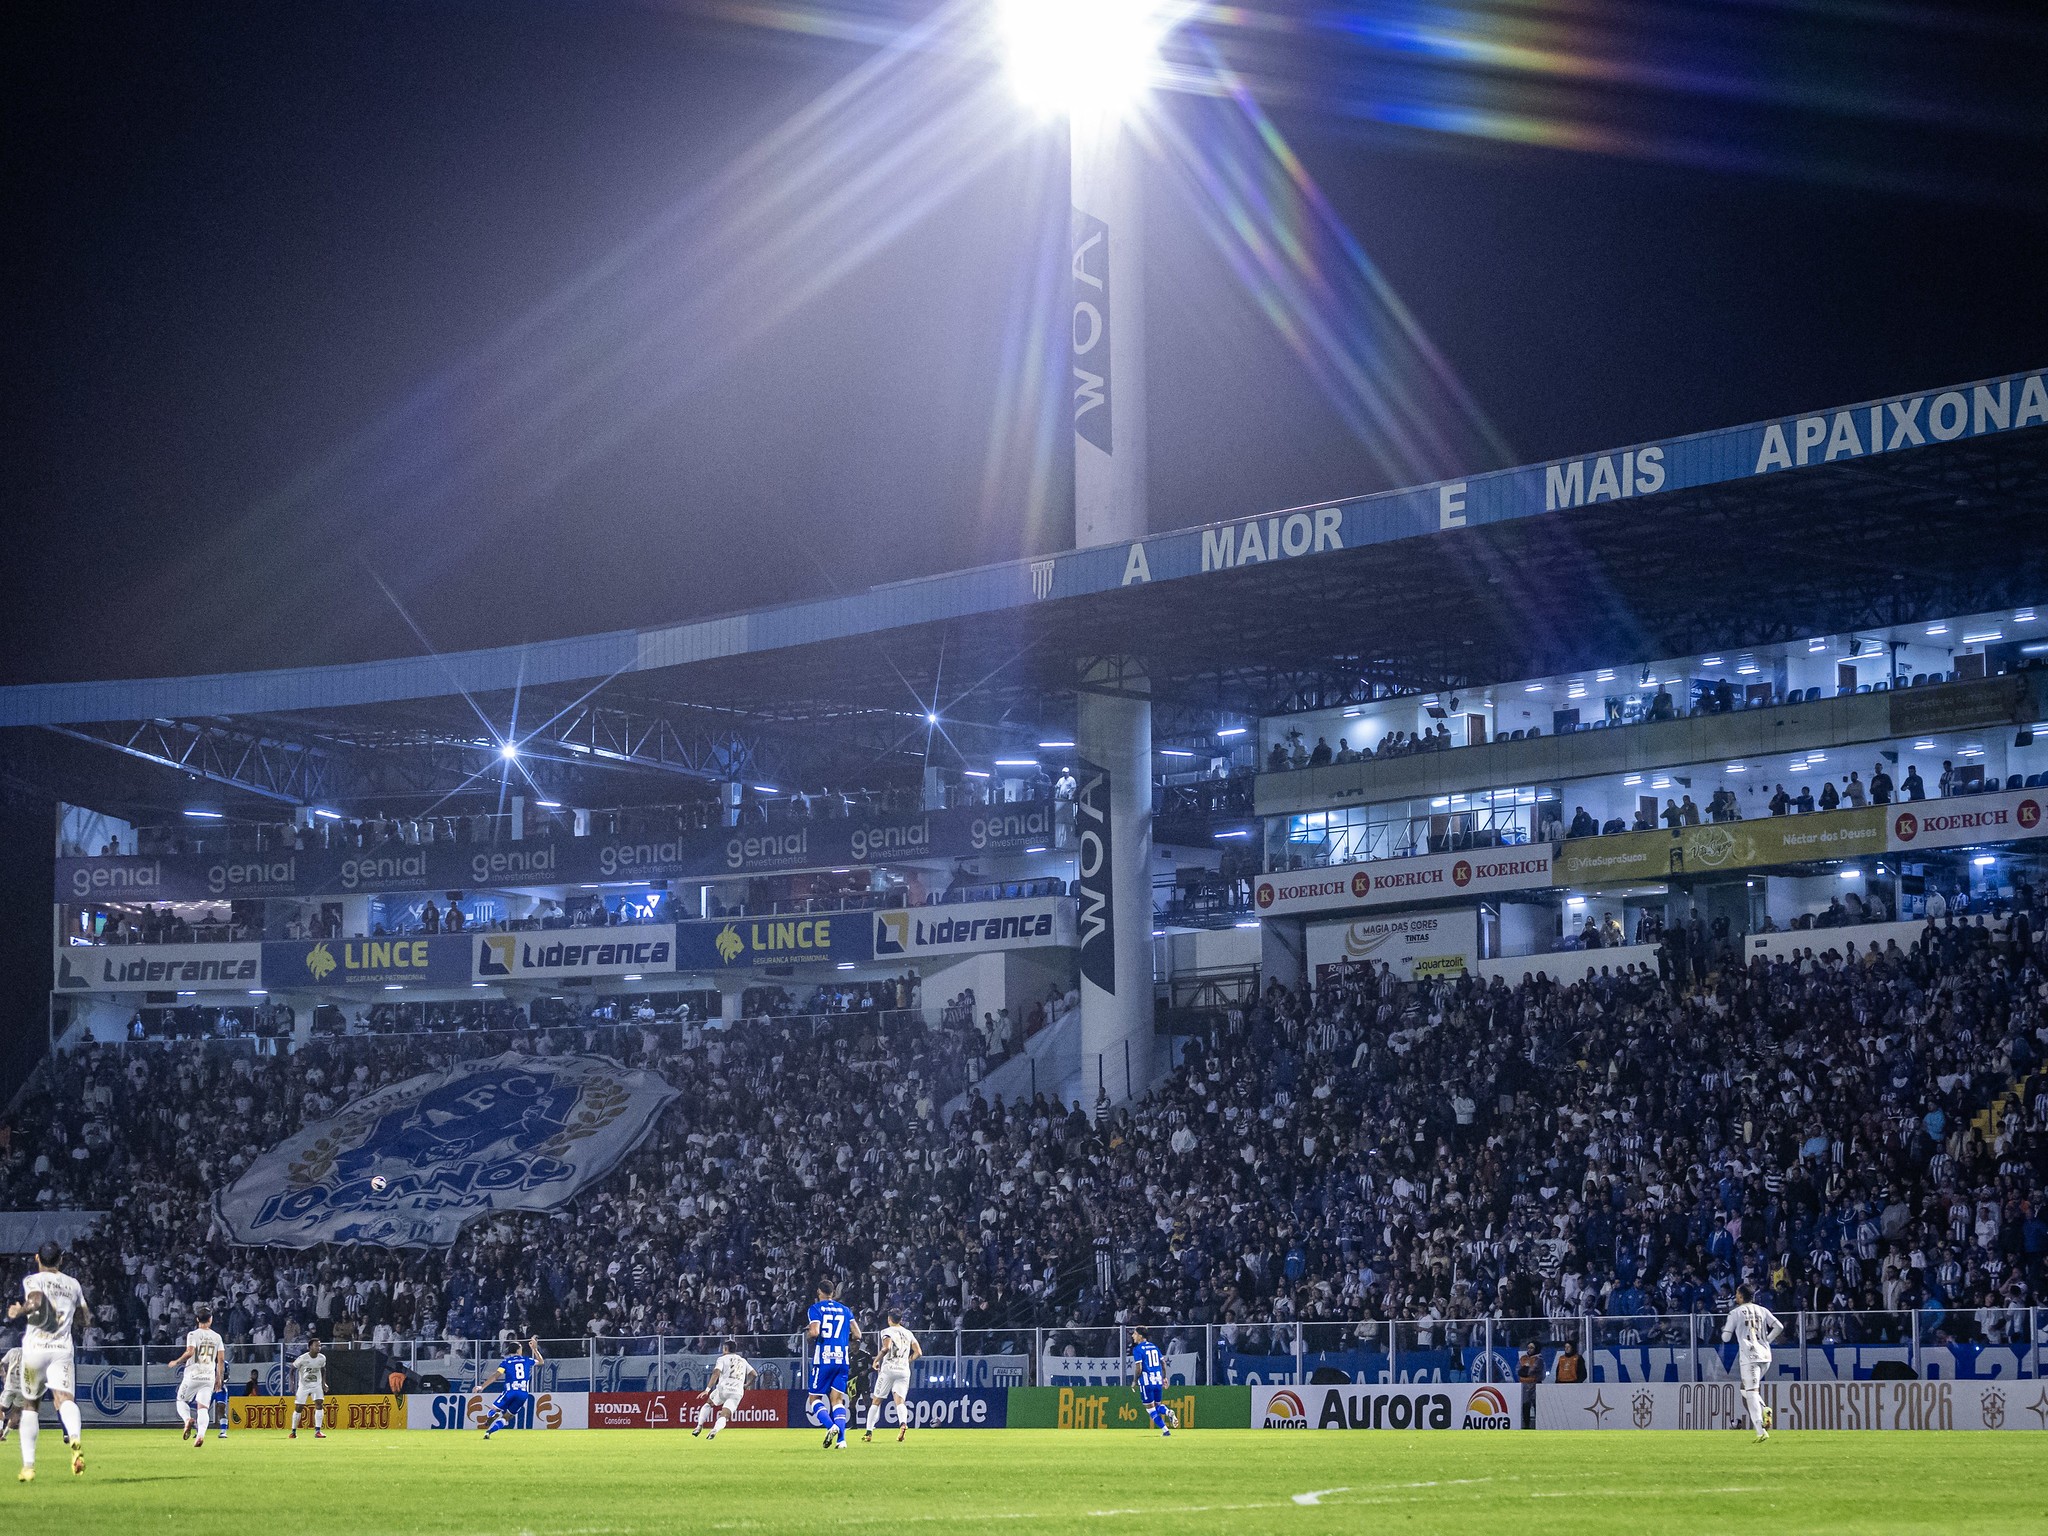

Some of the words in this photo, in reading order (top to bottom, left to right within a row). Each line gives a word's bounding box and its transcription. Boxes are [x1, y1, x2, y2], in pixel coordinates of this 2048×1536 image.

[1122, 543, 1151, 586] A
[1202, 507, 1344, 572] MAIOR
[1440, 482, 1467, 530] E
[1546, 446, 1666, 511] MAIS
[1755, 375, 2048, 474] APAIXONA
[971, 806, 1049, 849] genial
[1923, 810, 2009, 832] KOERICH
[727, 827, 807, 868] genial
[852, 818, 929, 859] genial
[1783, 833, 1818, 846] Néctar
[1820, 830, 1838, 842] dos
[342, 851, 426, 888] genial
[473, 844, 555, 882] genial
[600, 836, 683, 875] genial
[1080, 772, 1106, 951] WOA
[73, 861, 160, 897] genial
[209, 857, 295, 893] genial
[1278, 881, 1345, 900] KOERICH
[1374, 869, 1443, 889] KOERICH
[1476, 859, 1549, 878] KOERICH
[752, 920, 831, 950] LINCE
[1363, 923, 1389, 935] MAGIA
[1392, 921, 1408, 932] DAS
[1410, 919, 1438, 930] CORES
[1405, 933, 1430, 942] TINTAS
[345, 941, 429, 969] LINCE
[1422, 957, 1464, 970] quartzolit
[821, 1314, 845, 1339] 57
[514, 1363, 525, 1380] 8
[1145, 1349, 1160, 1368] 10
[431, 1395, 466, 1430] Sil
[594, 1403, 642, 1414] HONDA
[604, 1416, 631, 1425] Consórcio
[680, 1402, 687, 1422] É
[690, 1405, 714, 1422] fál
[727, 1406, 779, 1422] unciona.
[885, 1394, 987, 1429] esporte
[1318, 1388, 1452, 1430] Aurora
[1462, 1414, 1511, 1430] Aurora
[1679, 1383, 1735, 1430] COPA
[1894, 1382, 1953, 1430] 2026
[1263, 1417, 1308, 1429] Aurora
